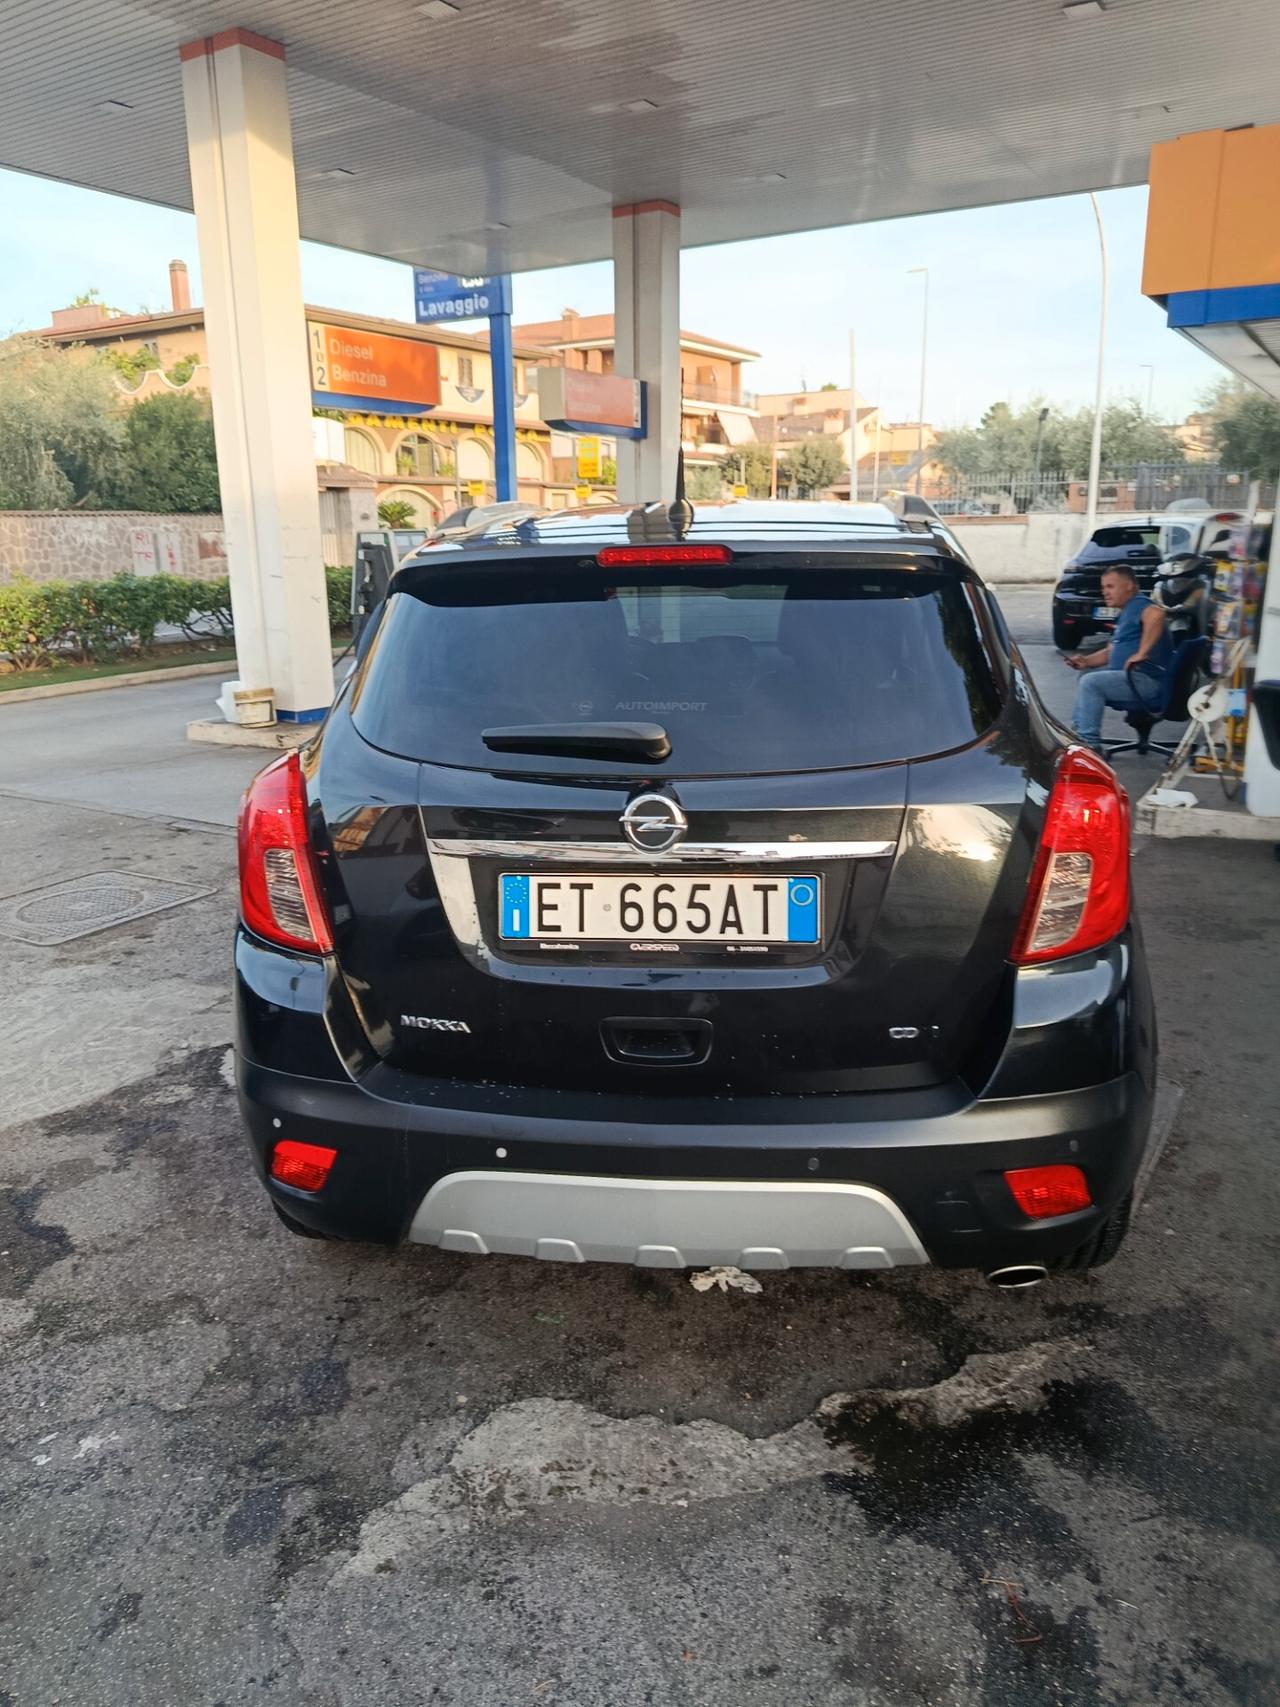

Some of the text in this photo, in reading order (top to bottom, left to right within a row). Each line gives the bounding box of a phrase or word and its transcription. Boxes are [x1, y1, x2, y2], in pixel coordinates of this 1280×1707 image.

[418, 293, 489, 317] Lavaggio
[329, 337, 374, 361] Diesel
[316, 366, 327, 386] 2
[331, 363, 387, 387] Benzina
[614, 701, 708, 711] AUTOIMPORT
[537, 882, 594, 932] ET
[619, 882, 779, 935] 665AT
[400, 1014, 472, 1034] MOKKA
